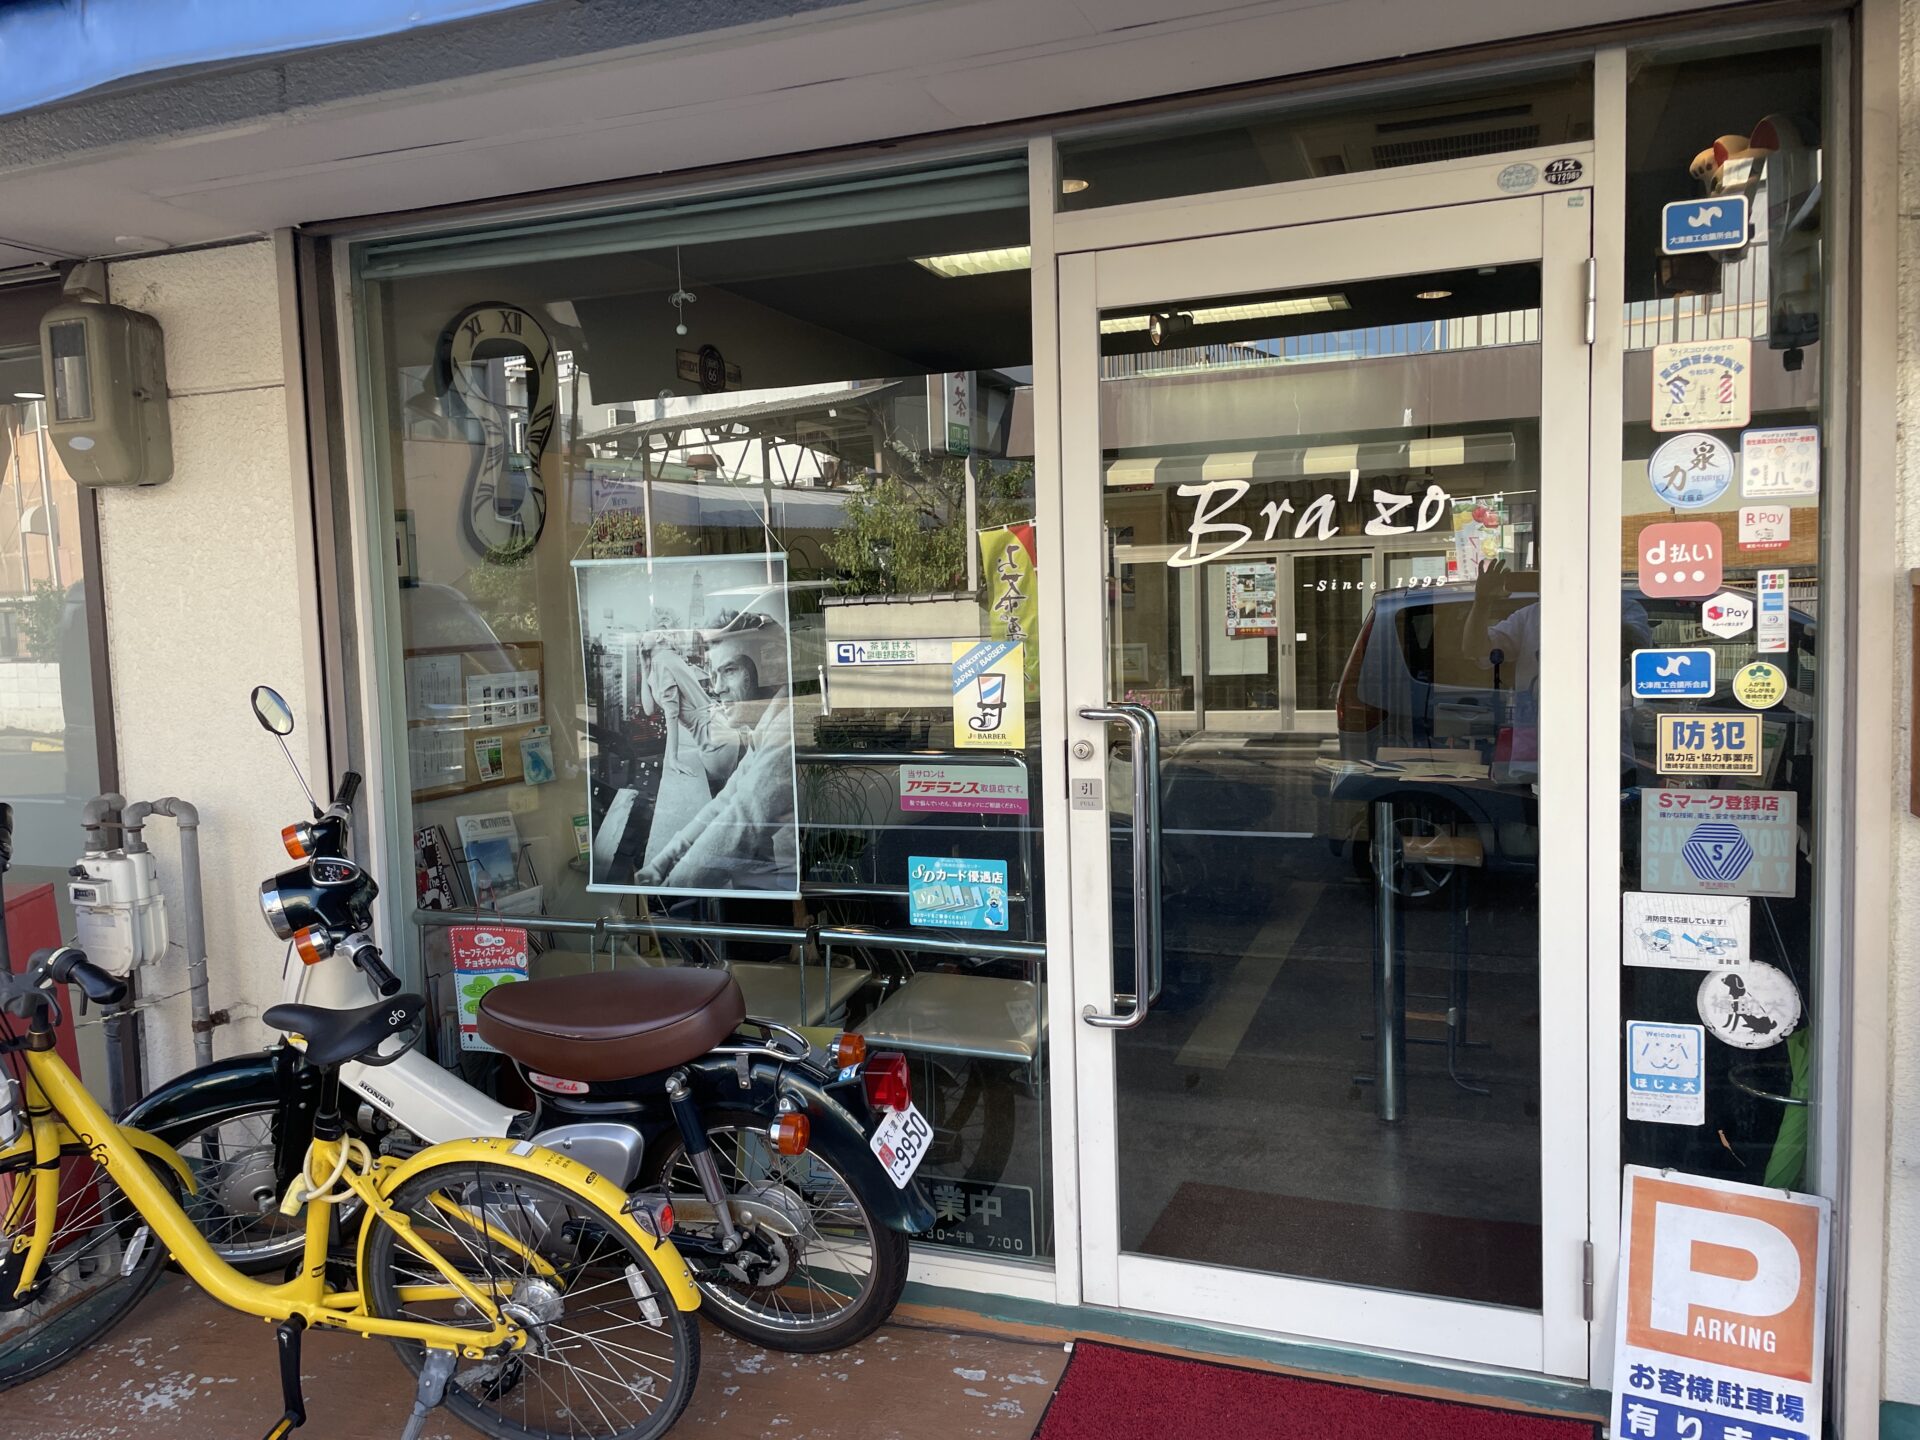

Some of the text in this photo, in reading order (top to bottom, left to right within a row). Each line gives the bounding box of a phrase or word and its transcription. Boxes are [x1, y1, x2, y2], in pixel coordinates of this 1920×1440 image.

[498, 311, 522, 335] XII
[1166, 468, 1451, 568] Bra'zo
[1759, 513, 1784, 525] Pay
[1646, 540, 1713, 565] d払い
[1726, 607, 1748, 619] Pay
[954, 667, 976, 688] JAPAN
[979, 643, 1008, 668] BARBER
[956, 649, 987, 672] Welcome
[1638, 681, 1709, 689] 大津商工会議所会員
[1672, 721, 1746, 750] 防犯
[1665, 753, 1754, 762] 協力店・協力事業所
[907, 769, 945, 779] 当サロンは
[1081, 782, 1093, 796] 引
[1659, 792, 1780, 811] Sマーク登録店
[1712, 844, 1723, 861] S
[458, 946, 515, 957] セーフティステーション
[389, 1010, 406, 1026] ofo
[1635, 1078, 1696, 1093] ほじょ犬
[360, 1082, 392, 1109] HONDA
[921, 1183, 1002, 1226] 業中
[987, 1234, 1023, 1250] 7:00
[1628, 1363, 1805, 1424] お客様駐車場
